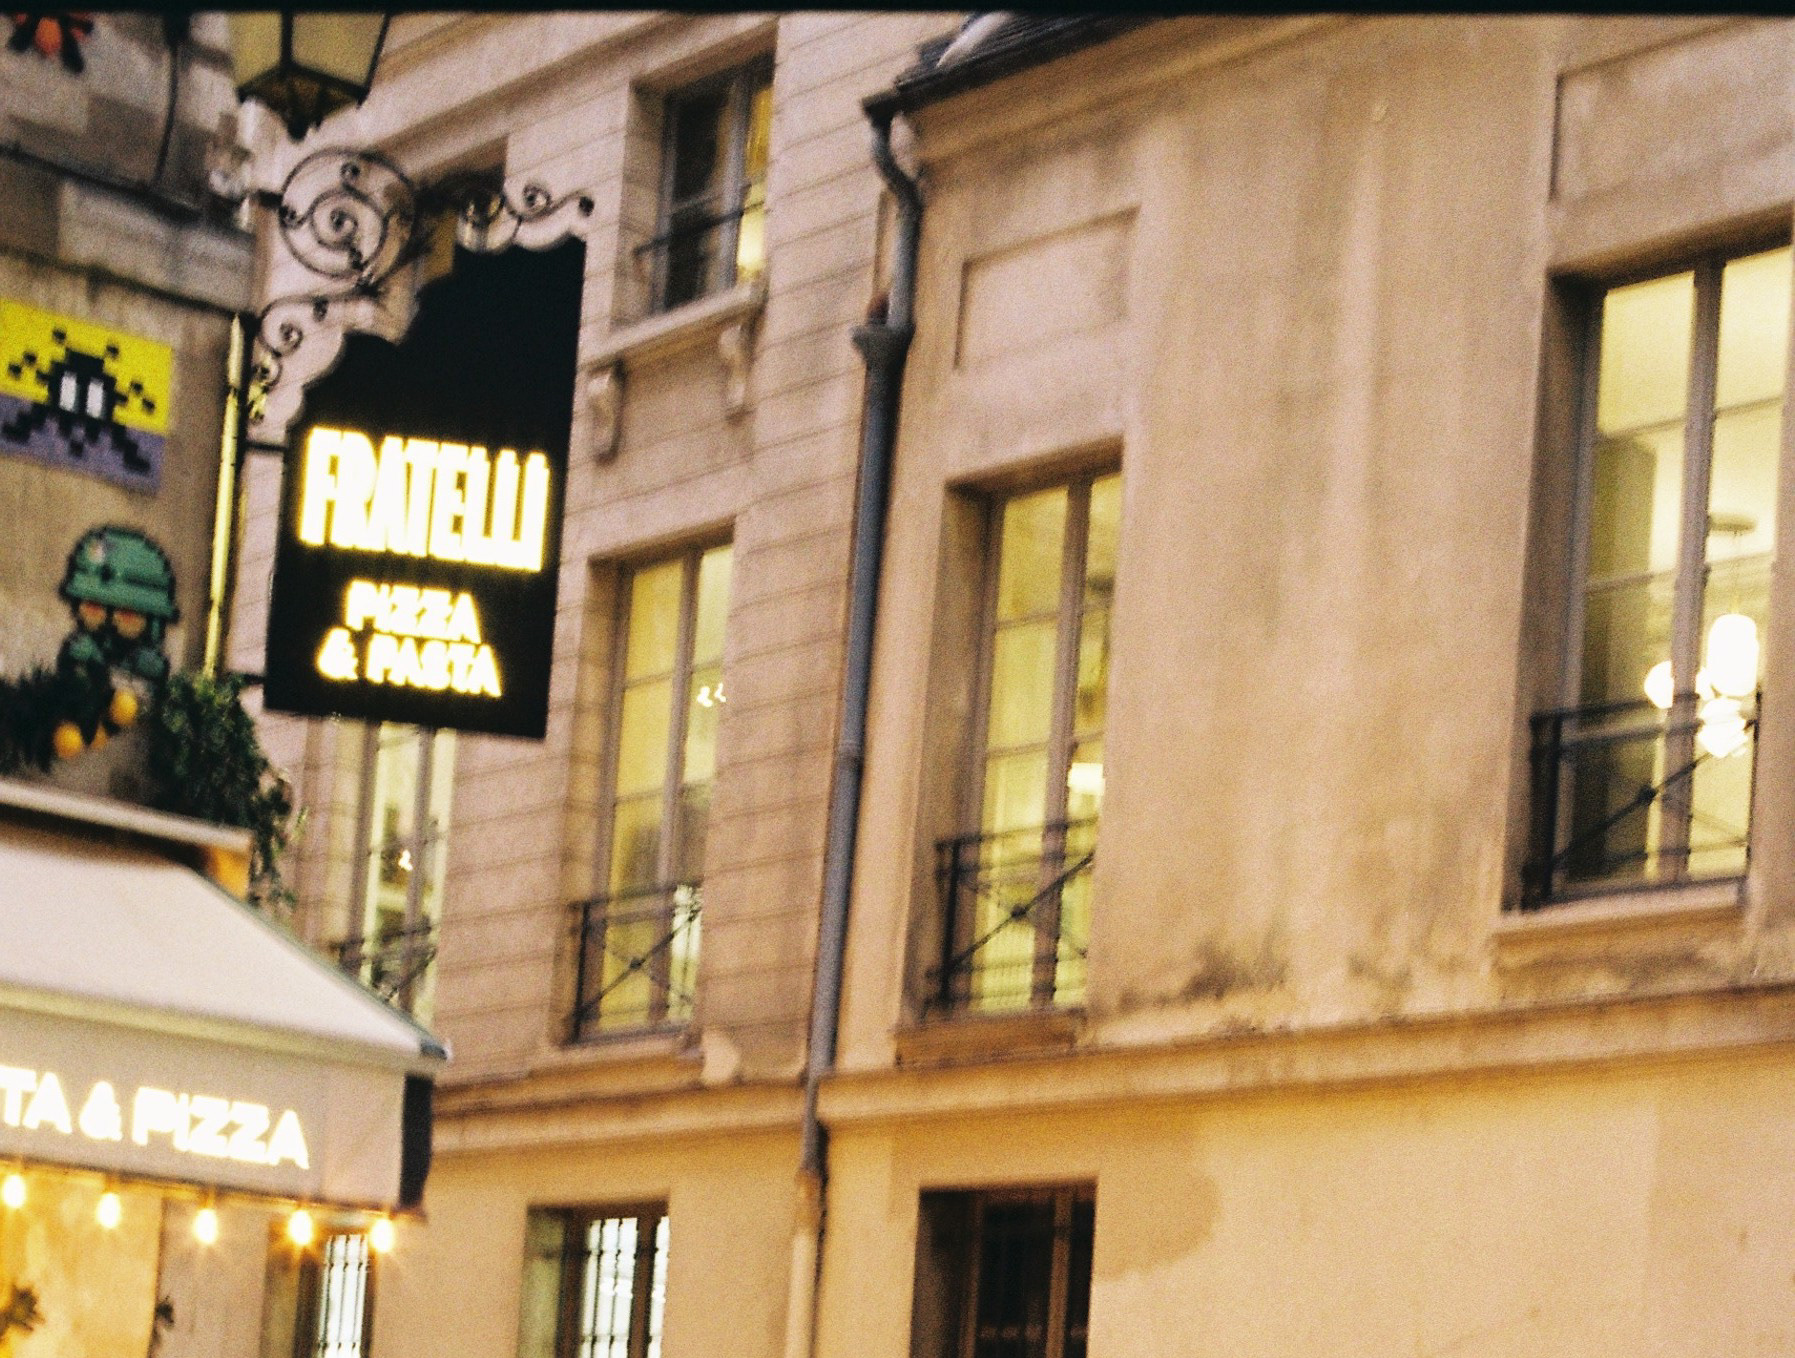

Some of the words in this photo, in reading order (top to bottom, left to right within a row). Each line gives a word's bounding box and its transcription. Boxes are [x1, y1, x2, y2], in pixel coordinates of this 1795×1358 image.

[300, 428, 550, 571] FRATELLI
[346, 581, 481, 644] PIZZA
[318, 629, 358, 680] &
[366, 634, 501, 697] PASTA
[79, 1081, 122, 1141] &
[132, 1087, 309, 1169] PIZZA
